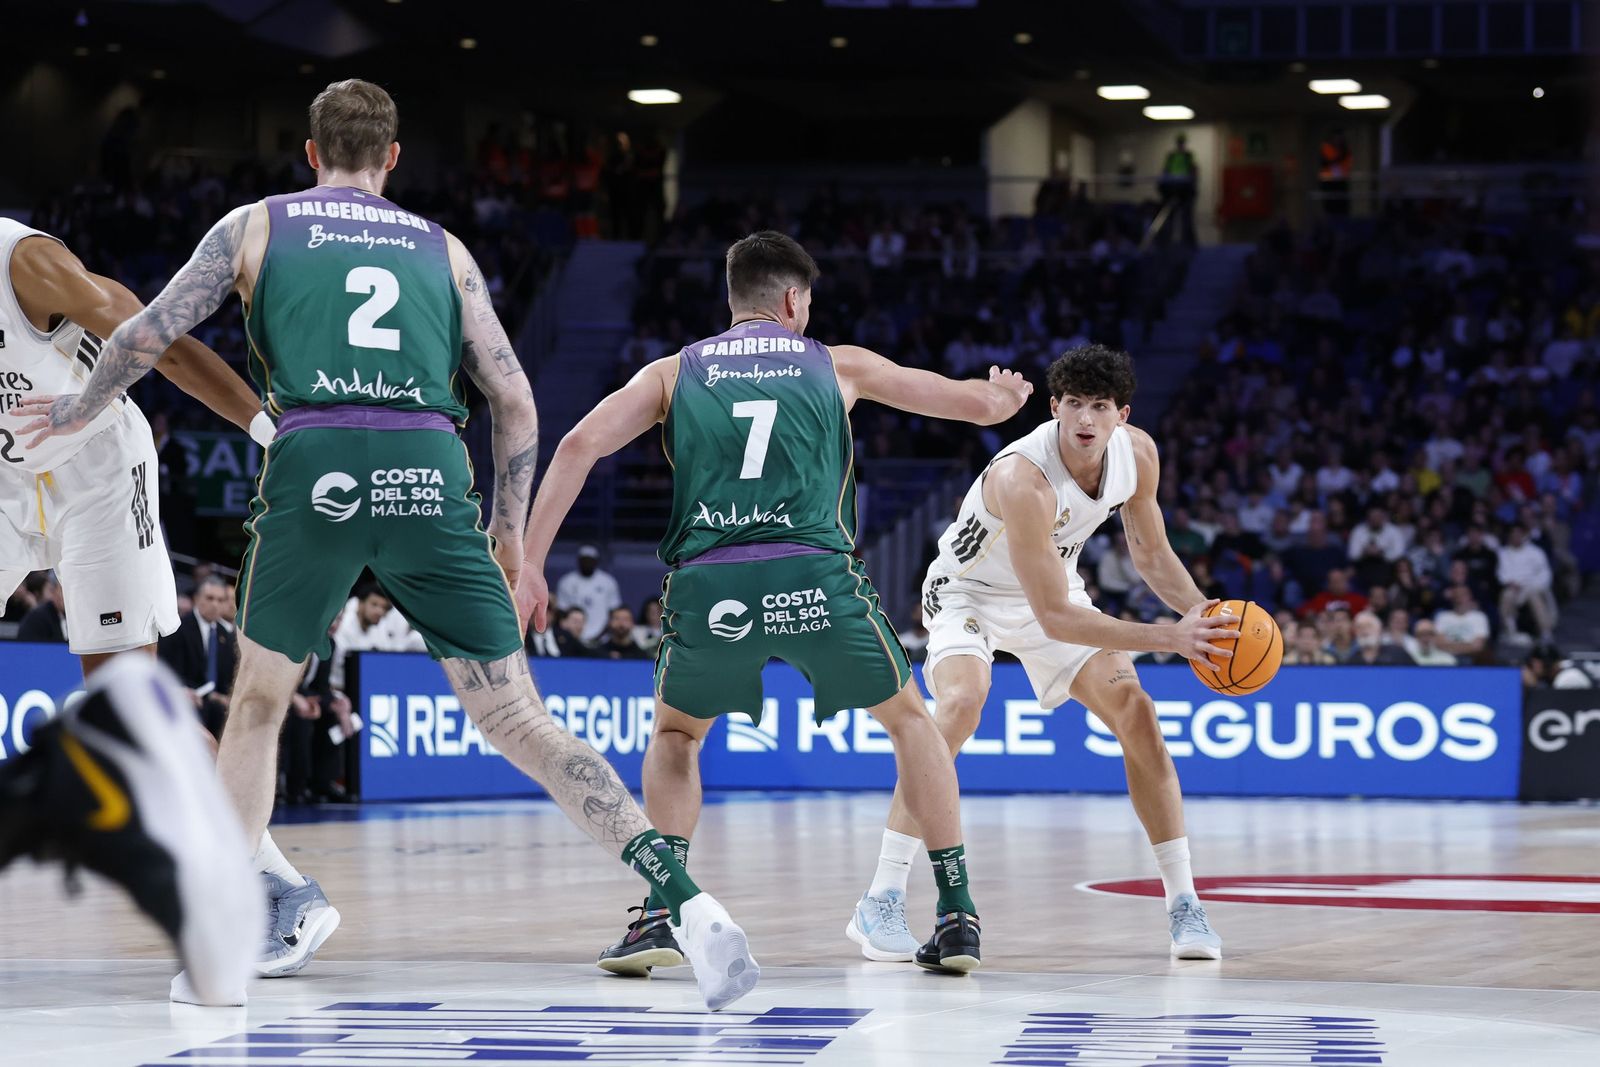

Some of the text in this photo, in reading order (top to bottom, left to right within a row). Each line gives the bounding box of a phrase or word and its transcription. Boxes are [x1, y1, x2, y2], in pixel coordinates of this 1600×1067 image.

[286, 201, 431, 233] BALCEROWSKI
[345, 266, 401, 351] 2
[701, 337, 806, 357] BARREIRO
[310, 367, 428, 405] Andalucía
[732, 399, 778, 480] 7
[370, 468, 444, 486] COSTA
[371, 487, 444, 502] DEL SOL
[371, 501, 443, 517] MÁLAGA
[692, 501, 795, 528] Andalucía
[761, 587, 828, 609] COSTA
[102, 617, 118, 625] acb
[763, 604, 830, 623] DEL SOL
[764, 618, 832, 635] MÁLAGA
[406, 694, 502, 757] REA
[545, 694, 656, 754] SEGUR
[634, 843, 671, 887] UNICAJA
